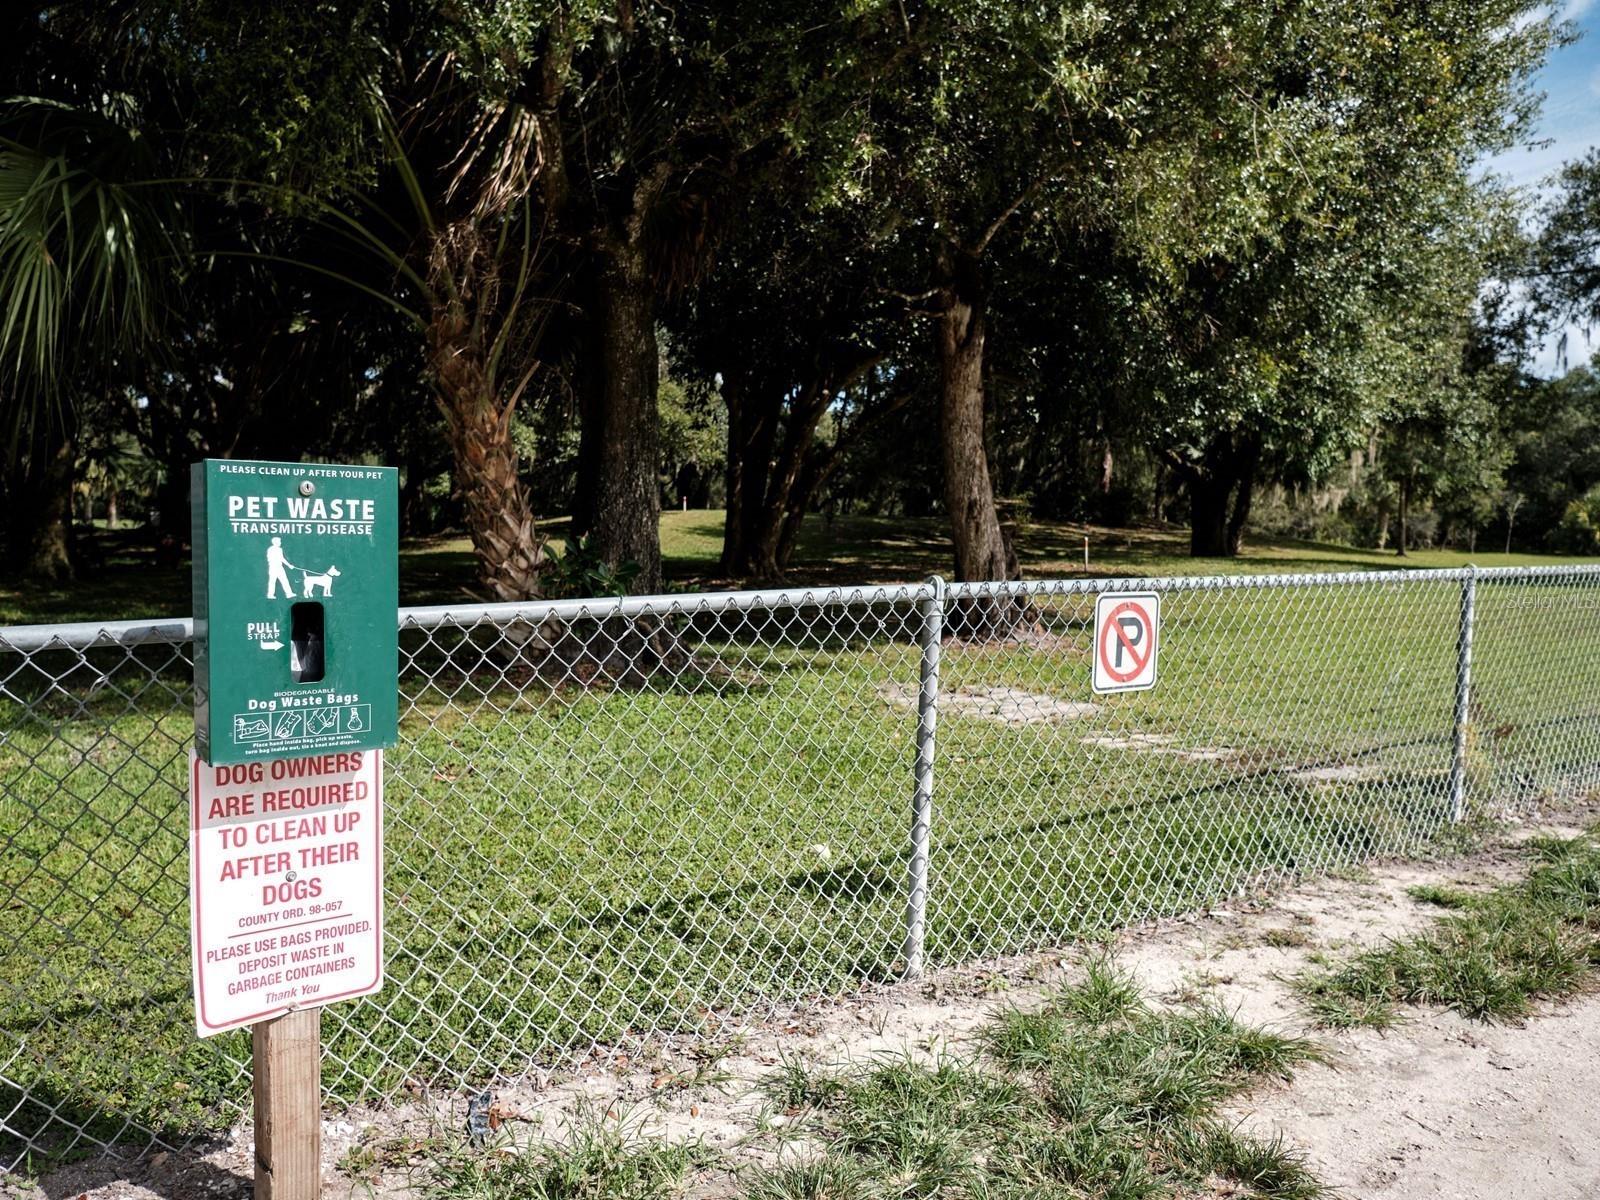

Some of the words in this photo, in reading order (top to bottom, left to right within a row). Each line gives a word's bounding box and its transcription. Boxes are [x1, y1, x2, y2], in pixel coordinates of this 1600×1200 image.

[220, 465, 256, 475] PLEASE
[258, 467, 290, 476] CLEAN
[293, 468, 306, 477] UP
[309, 469, 337, 478] AFTER
[339, 470, 364, 479] YOUR
[366, 471, 382, 480] PET
[228, 495, 278, 518] PET
[287, 497, 375, 520] WASTE
[231, 522, 312, 534] TRANSMITS
[317, 523, 372, 535] DISEASE
[247, 622, 280, 633] PULL
[247, 632, 280, 640] STRAP
[1115, 617, 1143, 668] P
[248, 699, 276, 711] Dog
[282, 694, 323, 708] Waste
[327, 692, 359, 706] Bags
[274, 688, 336, 698] BIODEGRADABLE
[216, 762, 264, 786] DOG
[271, 752, 363, 780] OWNERS
[208, 794, 255, 820] ARE
[262, 781, 368, 812] REQUIRED
[218, 826, 248, 850] TO
[256, 815, 327, 845] CLEAN
[334, 812, 361, 833] UP
[220, 852, 291, 882] AFTER
[298, 842, 359, 869] THEIR
[262, 877, 322, 906] DOGS
[238, 912, 280, 928] COUNTY
[282, 908, 306, 920] ORD.
[309, 900, 343, 916] 98-057
[206, 943, 252, 964] PLEASE
[254, 938, 277, 953] USE
[280, 932, 312, 948] BAGS
[315, 920, 372, 941] PROVIDED.
[238, 954, 287, 974] DEPOSIT
[291, 945, 330, 963] WASTE
[333, 942, 345, 955] IN
[228, 972, 282, 996] GARBAGE
[285, 956, 356, 982] CONTAINERS
[265, 988, 298, 1004] Thank
[300, 983, 320, 996] You
